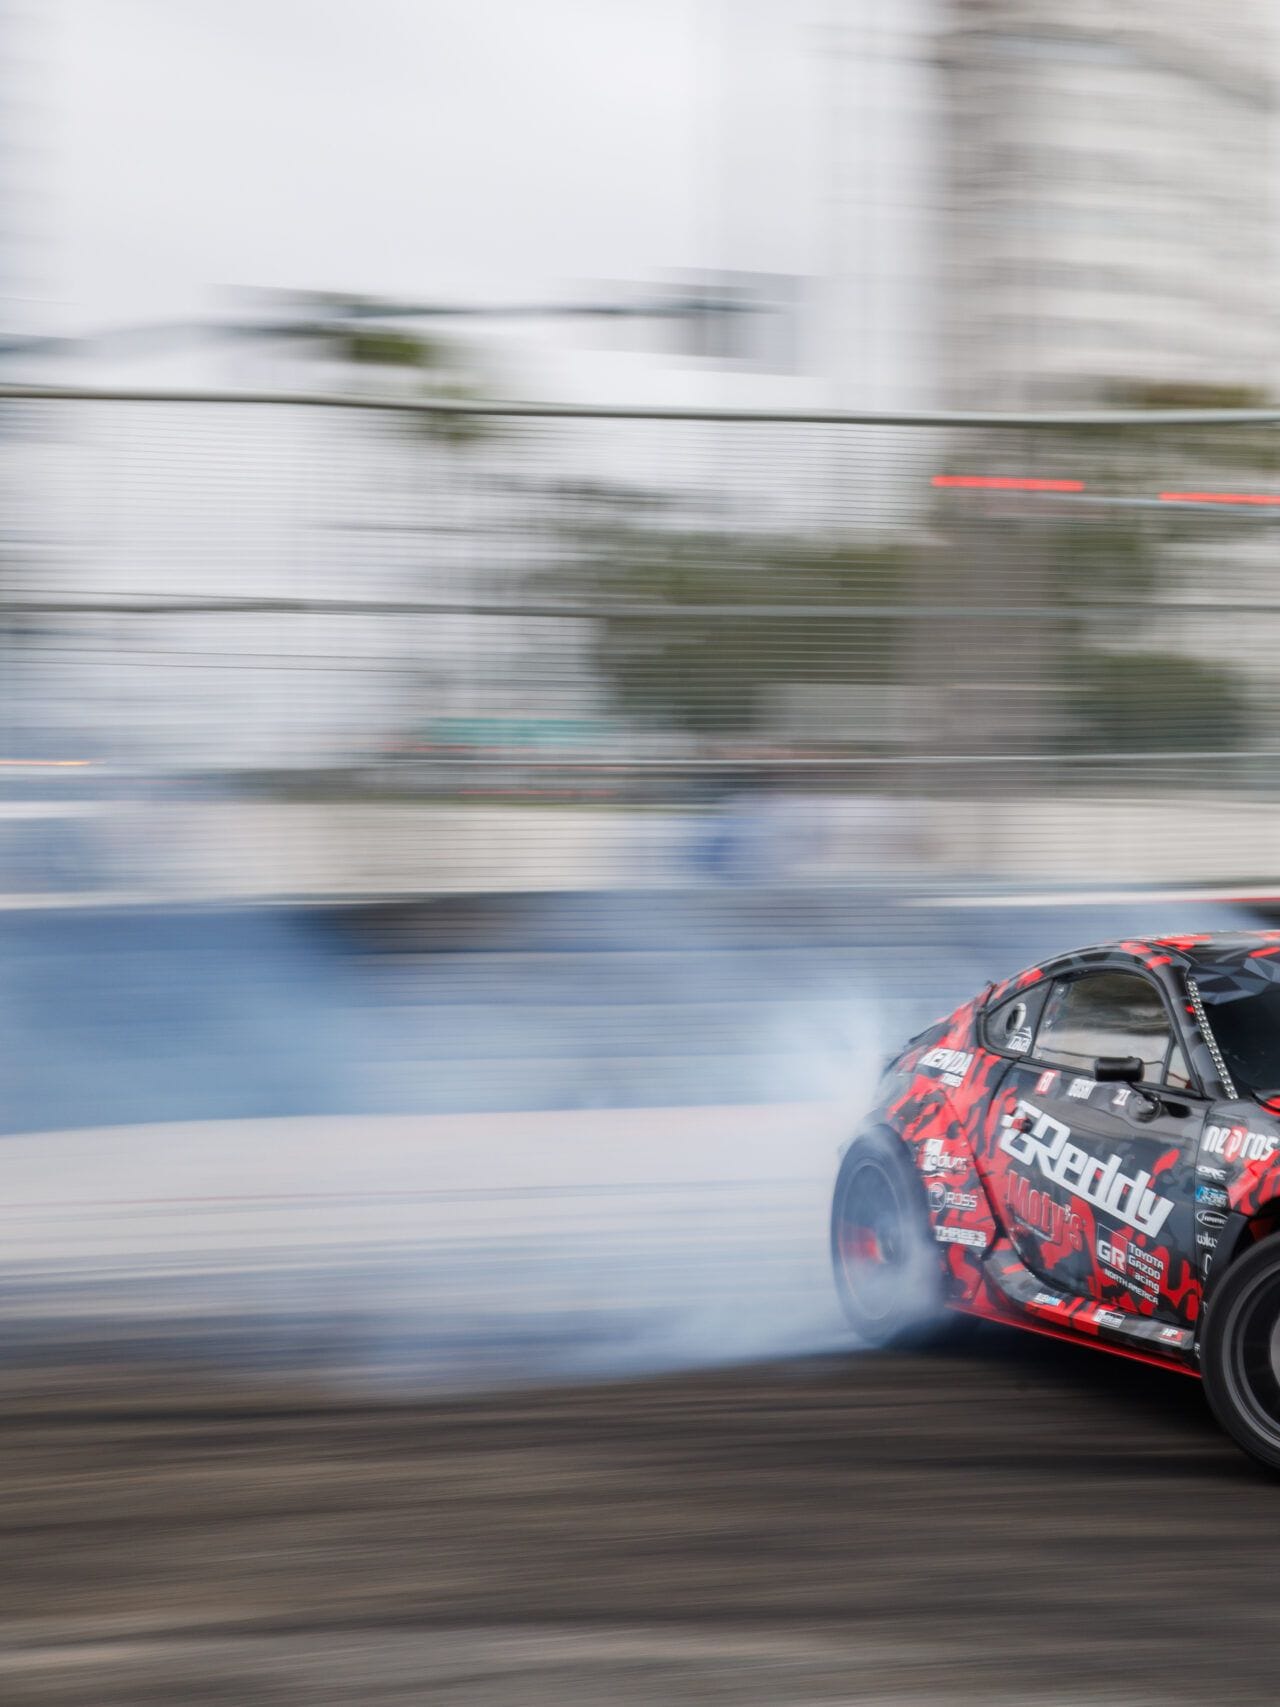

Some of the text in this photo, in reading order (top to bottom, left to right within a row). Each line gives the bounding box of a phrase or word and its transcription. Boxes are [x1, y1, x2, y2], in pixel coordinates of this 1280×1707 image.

[1098, 1239, 1164, 1272] GR TOYOTA
[1128, 1254, 1161, 1281] GAZOO
[1127, 1282, 1159, 1305] AMERICA
